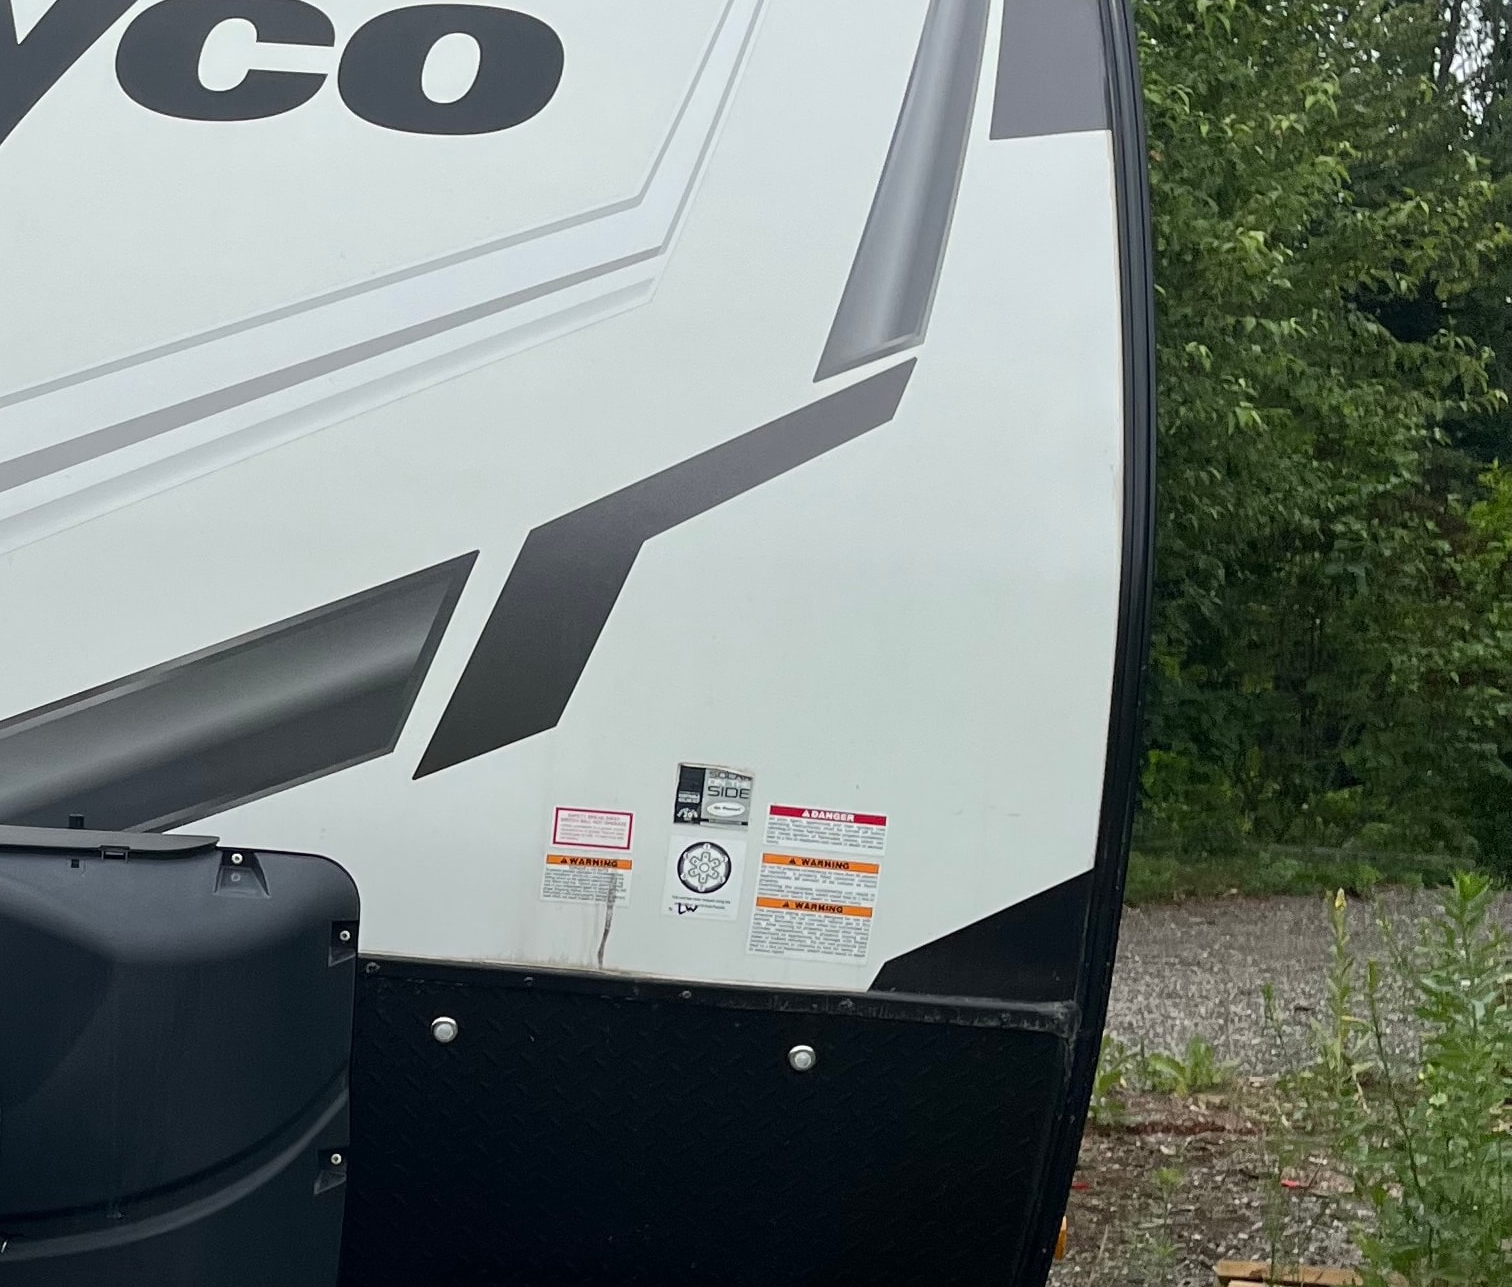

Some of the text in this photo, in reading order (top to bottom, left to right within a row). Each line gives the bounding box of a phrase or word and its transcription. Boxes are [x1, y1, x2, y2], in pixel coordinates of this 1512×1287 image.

[707, 785, 751, 799] SIDE
[811, 810, 855, 822] DANGER
[569, 857, 618, 867] WARNING
[801, 858, 850, 870] WARNING
[795, 902, 843, 913] WARNING
